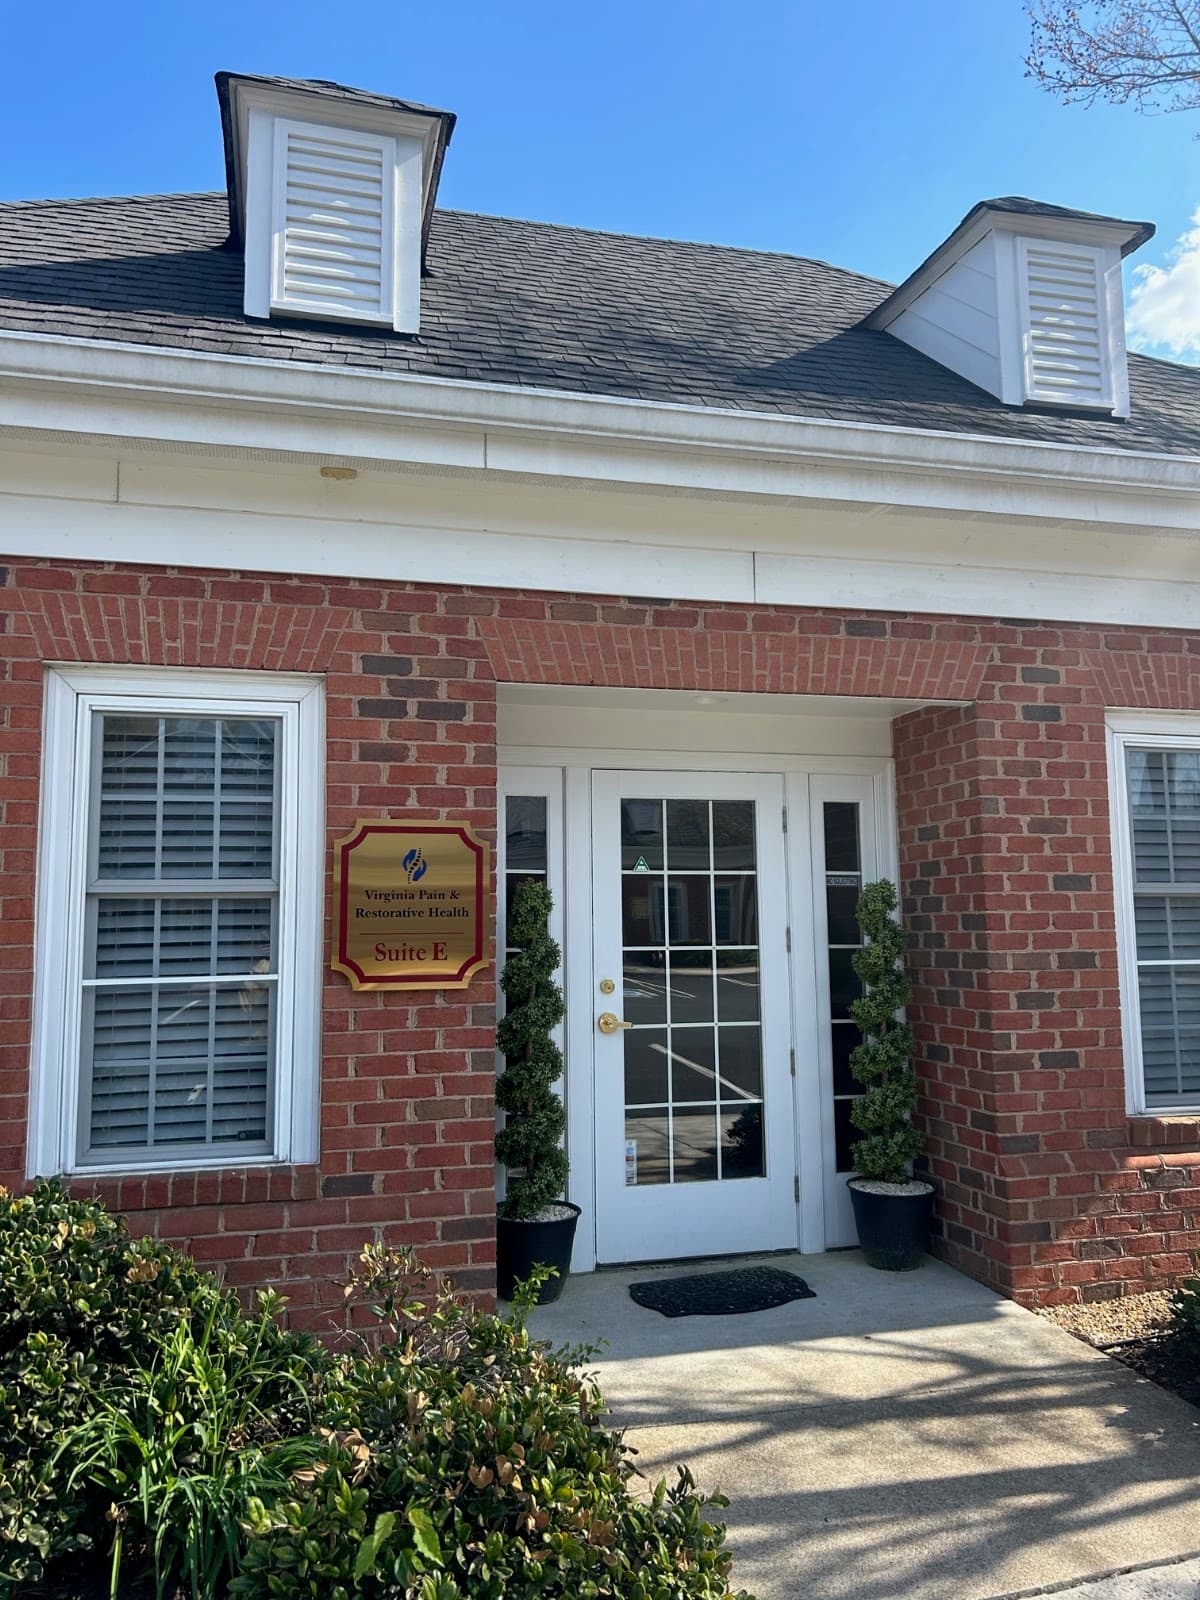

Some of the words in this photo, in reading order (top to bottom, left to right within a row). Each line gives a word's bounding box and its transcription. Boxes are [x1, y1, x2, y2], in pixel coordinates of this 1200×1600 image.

[364, 889, 414, 903] Virginia
[419, 889, 445, 900] Pain
[449, 890, 460, 900] &
[355, 907, 425, 918] Restorative
[428, 907, 469, 918] Health
[375, 942, 427, 961] Suite
[432, 942, 448, 961] E
